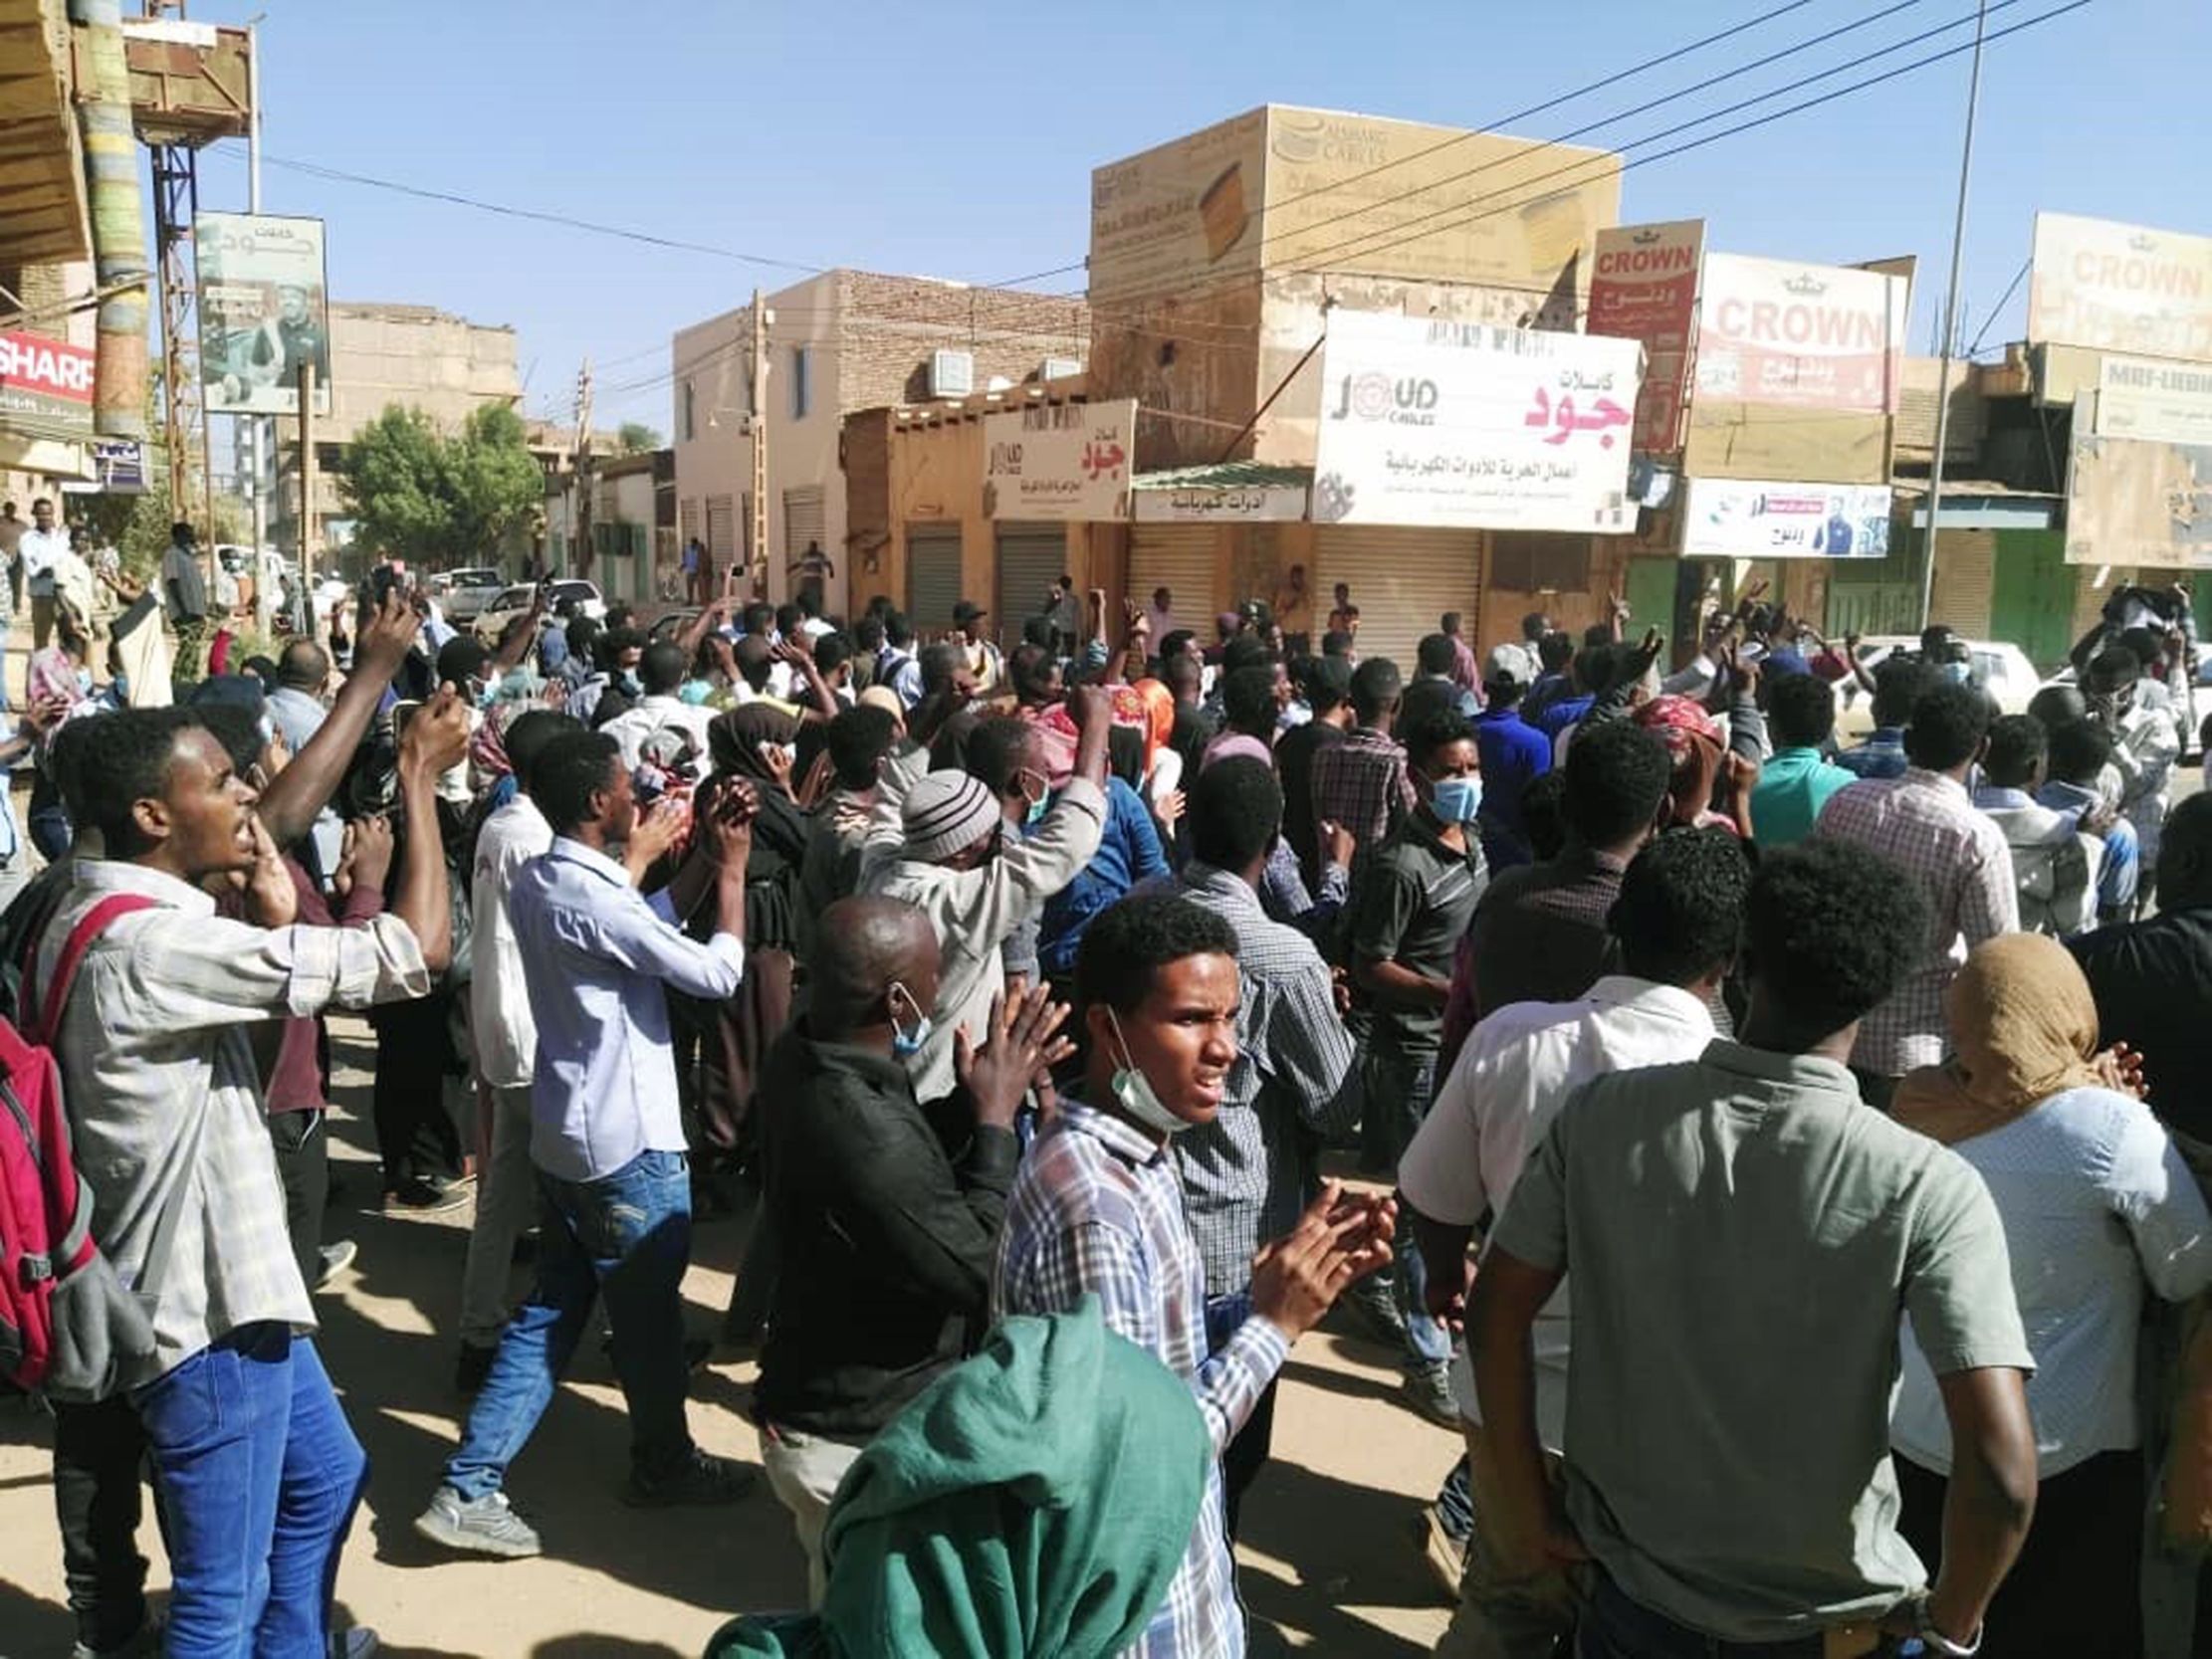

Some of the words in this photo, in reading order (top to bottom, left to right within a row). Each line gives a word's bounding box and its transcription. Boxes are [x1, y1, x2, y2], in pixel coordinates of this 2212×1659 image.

[1599, 245, 1692, 274] CROWN
[2075, 251, 2203, 297] CROWN
[1716, 298, 1883, 348] CROWN
[1330, 372, 1438, 419] JOUD
[1524, 386, 1631, 449] جود
